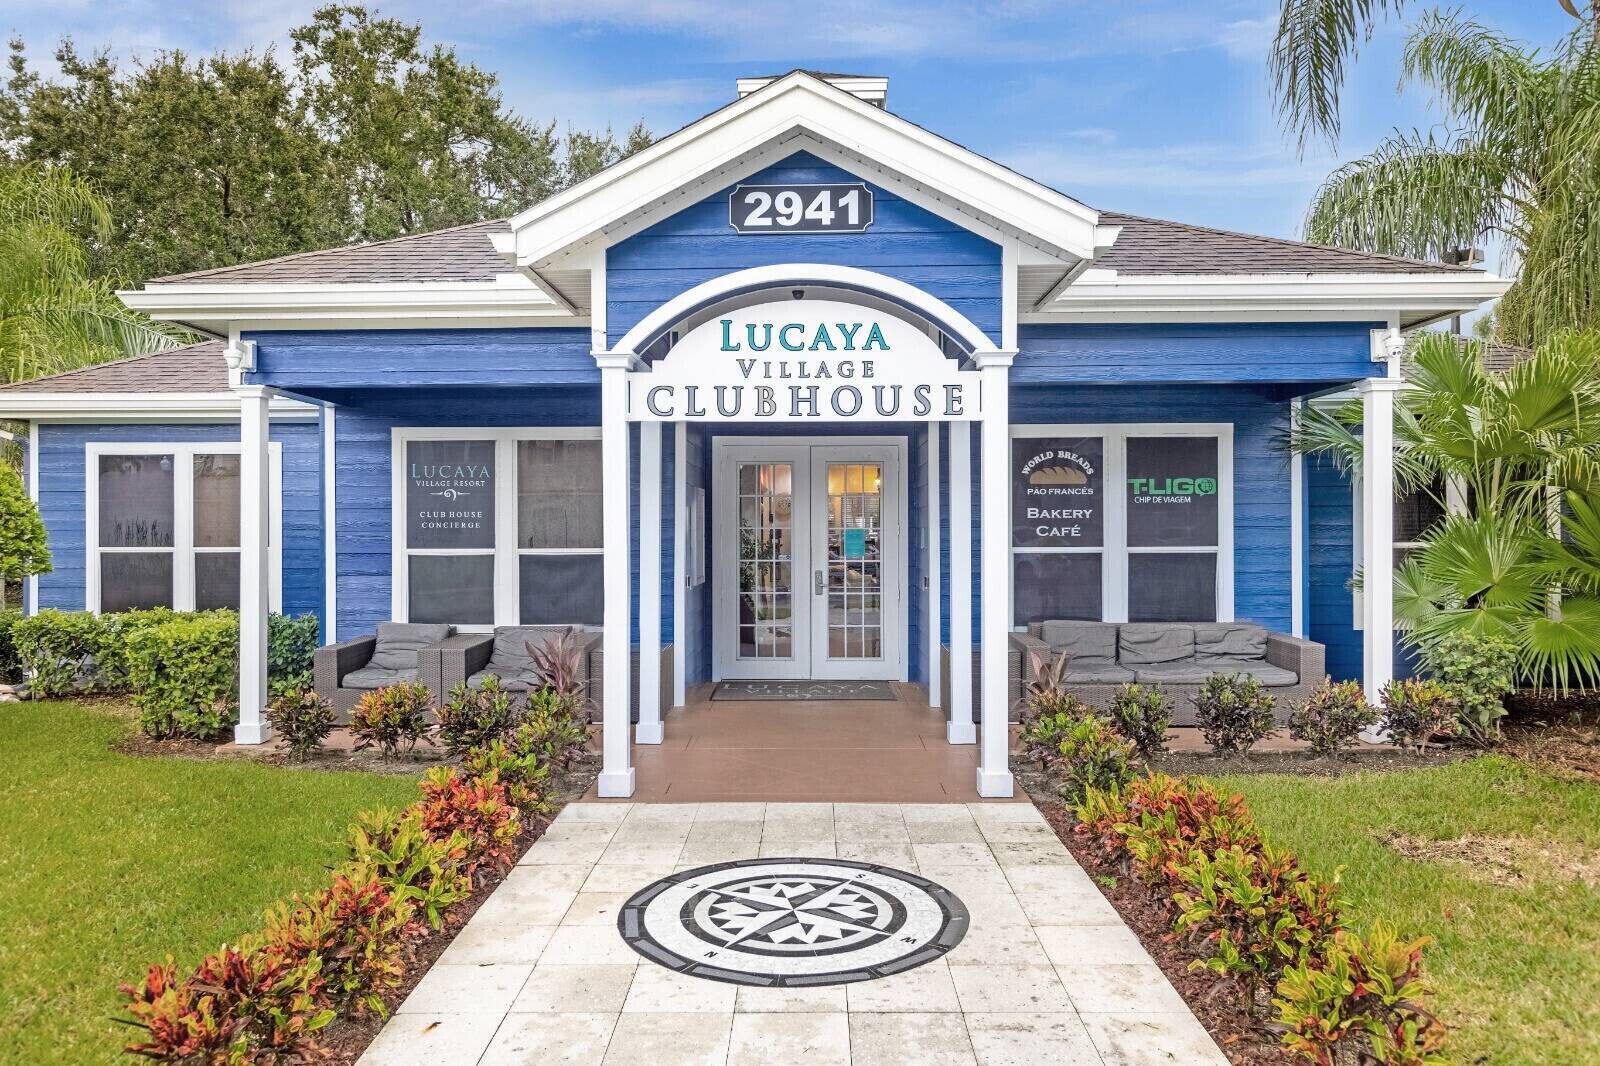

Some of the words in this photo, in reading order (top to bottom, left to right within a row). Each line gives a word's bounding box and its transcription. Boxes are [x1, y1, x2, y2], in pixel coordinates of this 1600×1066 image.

[743, 189, 860, 226] 2941
[720, 319, 890, 352] LUCAYA
[736, 358, 875, 379] VILLAGE
[646, 384, 964, 417] CLUBHOUSE
[411, 463, 490, 478] LUCAYA
[1021, 451, 1054, 475] WORLD
[1058, 450, 1094, 475] BREADS
[1026, 507, 1093, 519] BAKERY
[421, 521, 481, 529] CONCIERGE
